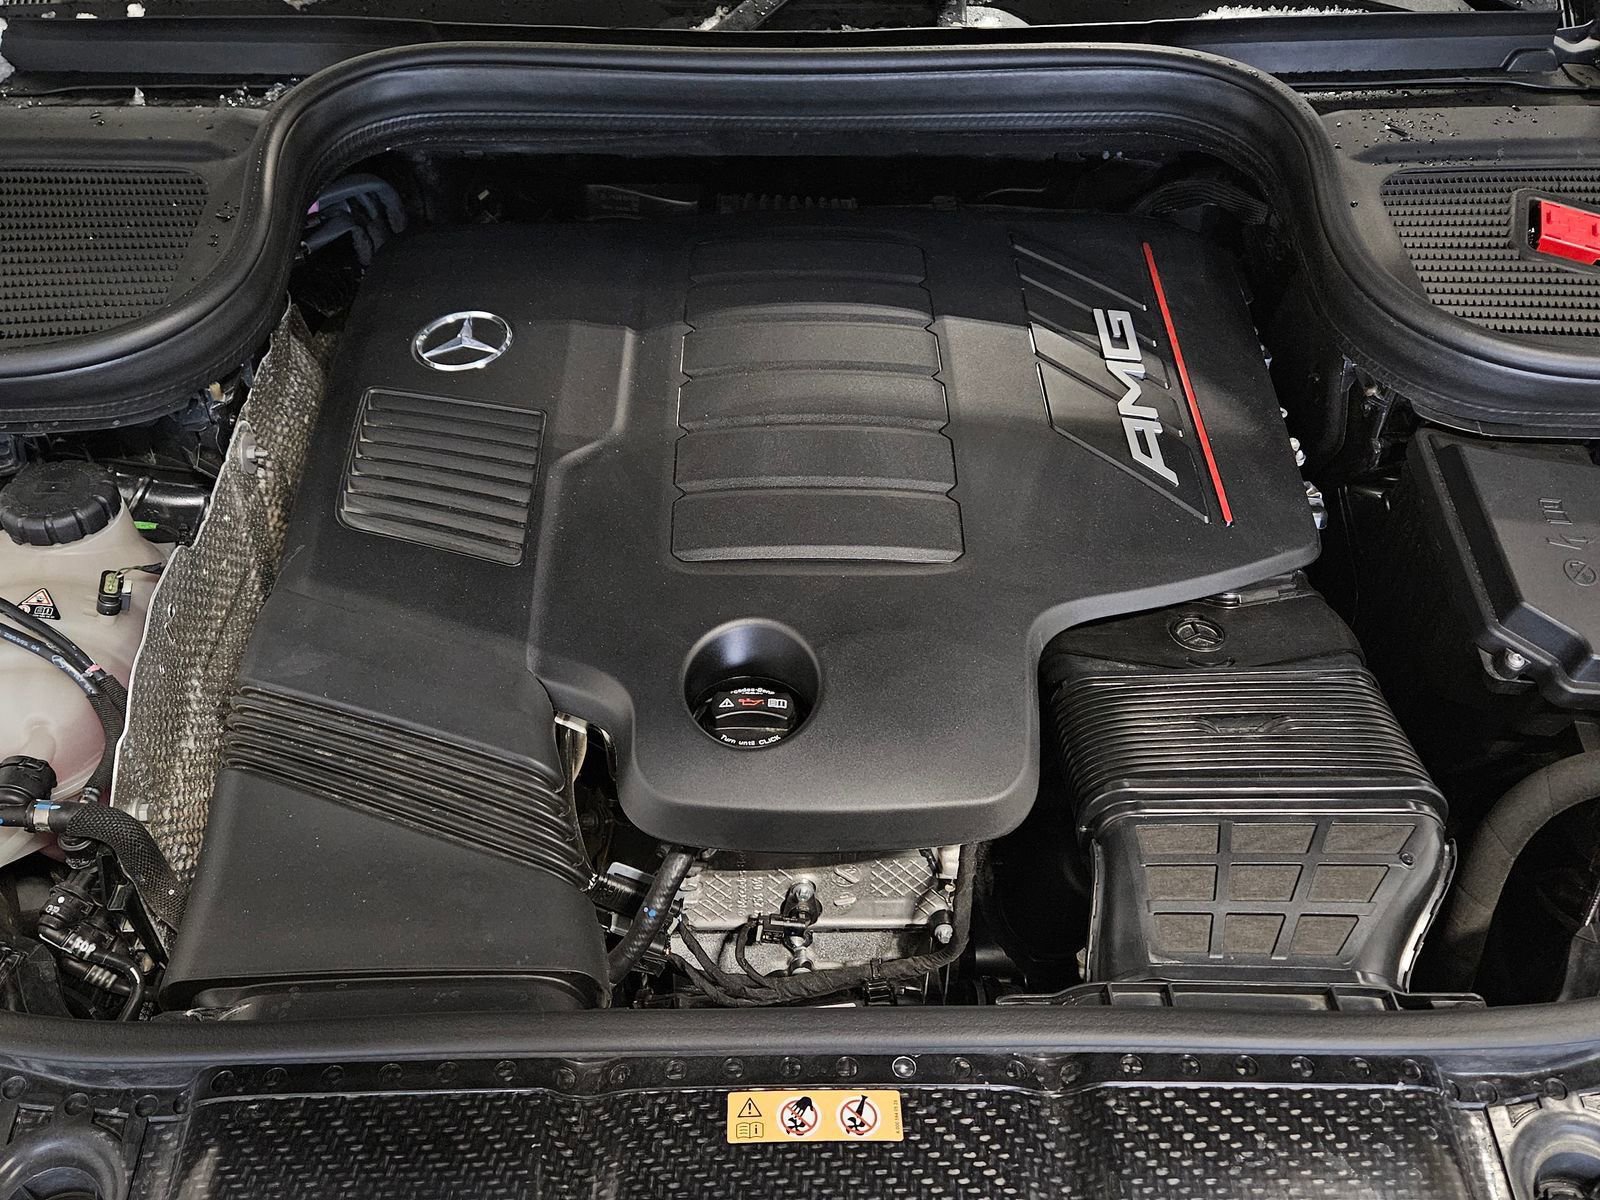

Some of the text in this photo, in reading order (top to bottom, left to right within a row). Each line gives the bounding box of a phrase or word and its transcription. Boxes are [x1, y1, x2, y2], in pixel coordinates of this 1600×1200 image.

[1092, 308, 1180, 487] AMG
[720, 734, 737, 744] Turn
[758, 734, 782, 745] CLICK
